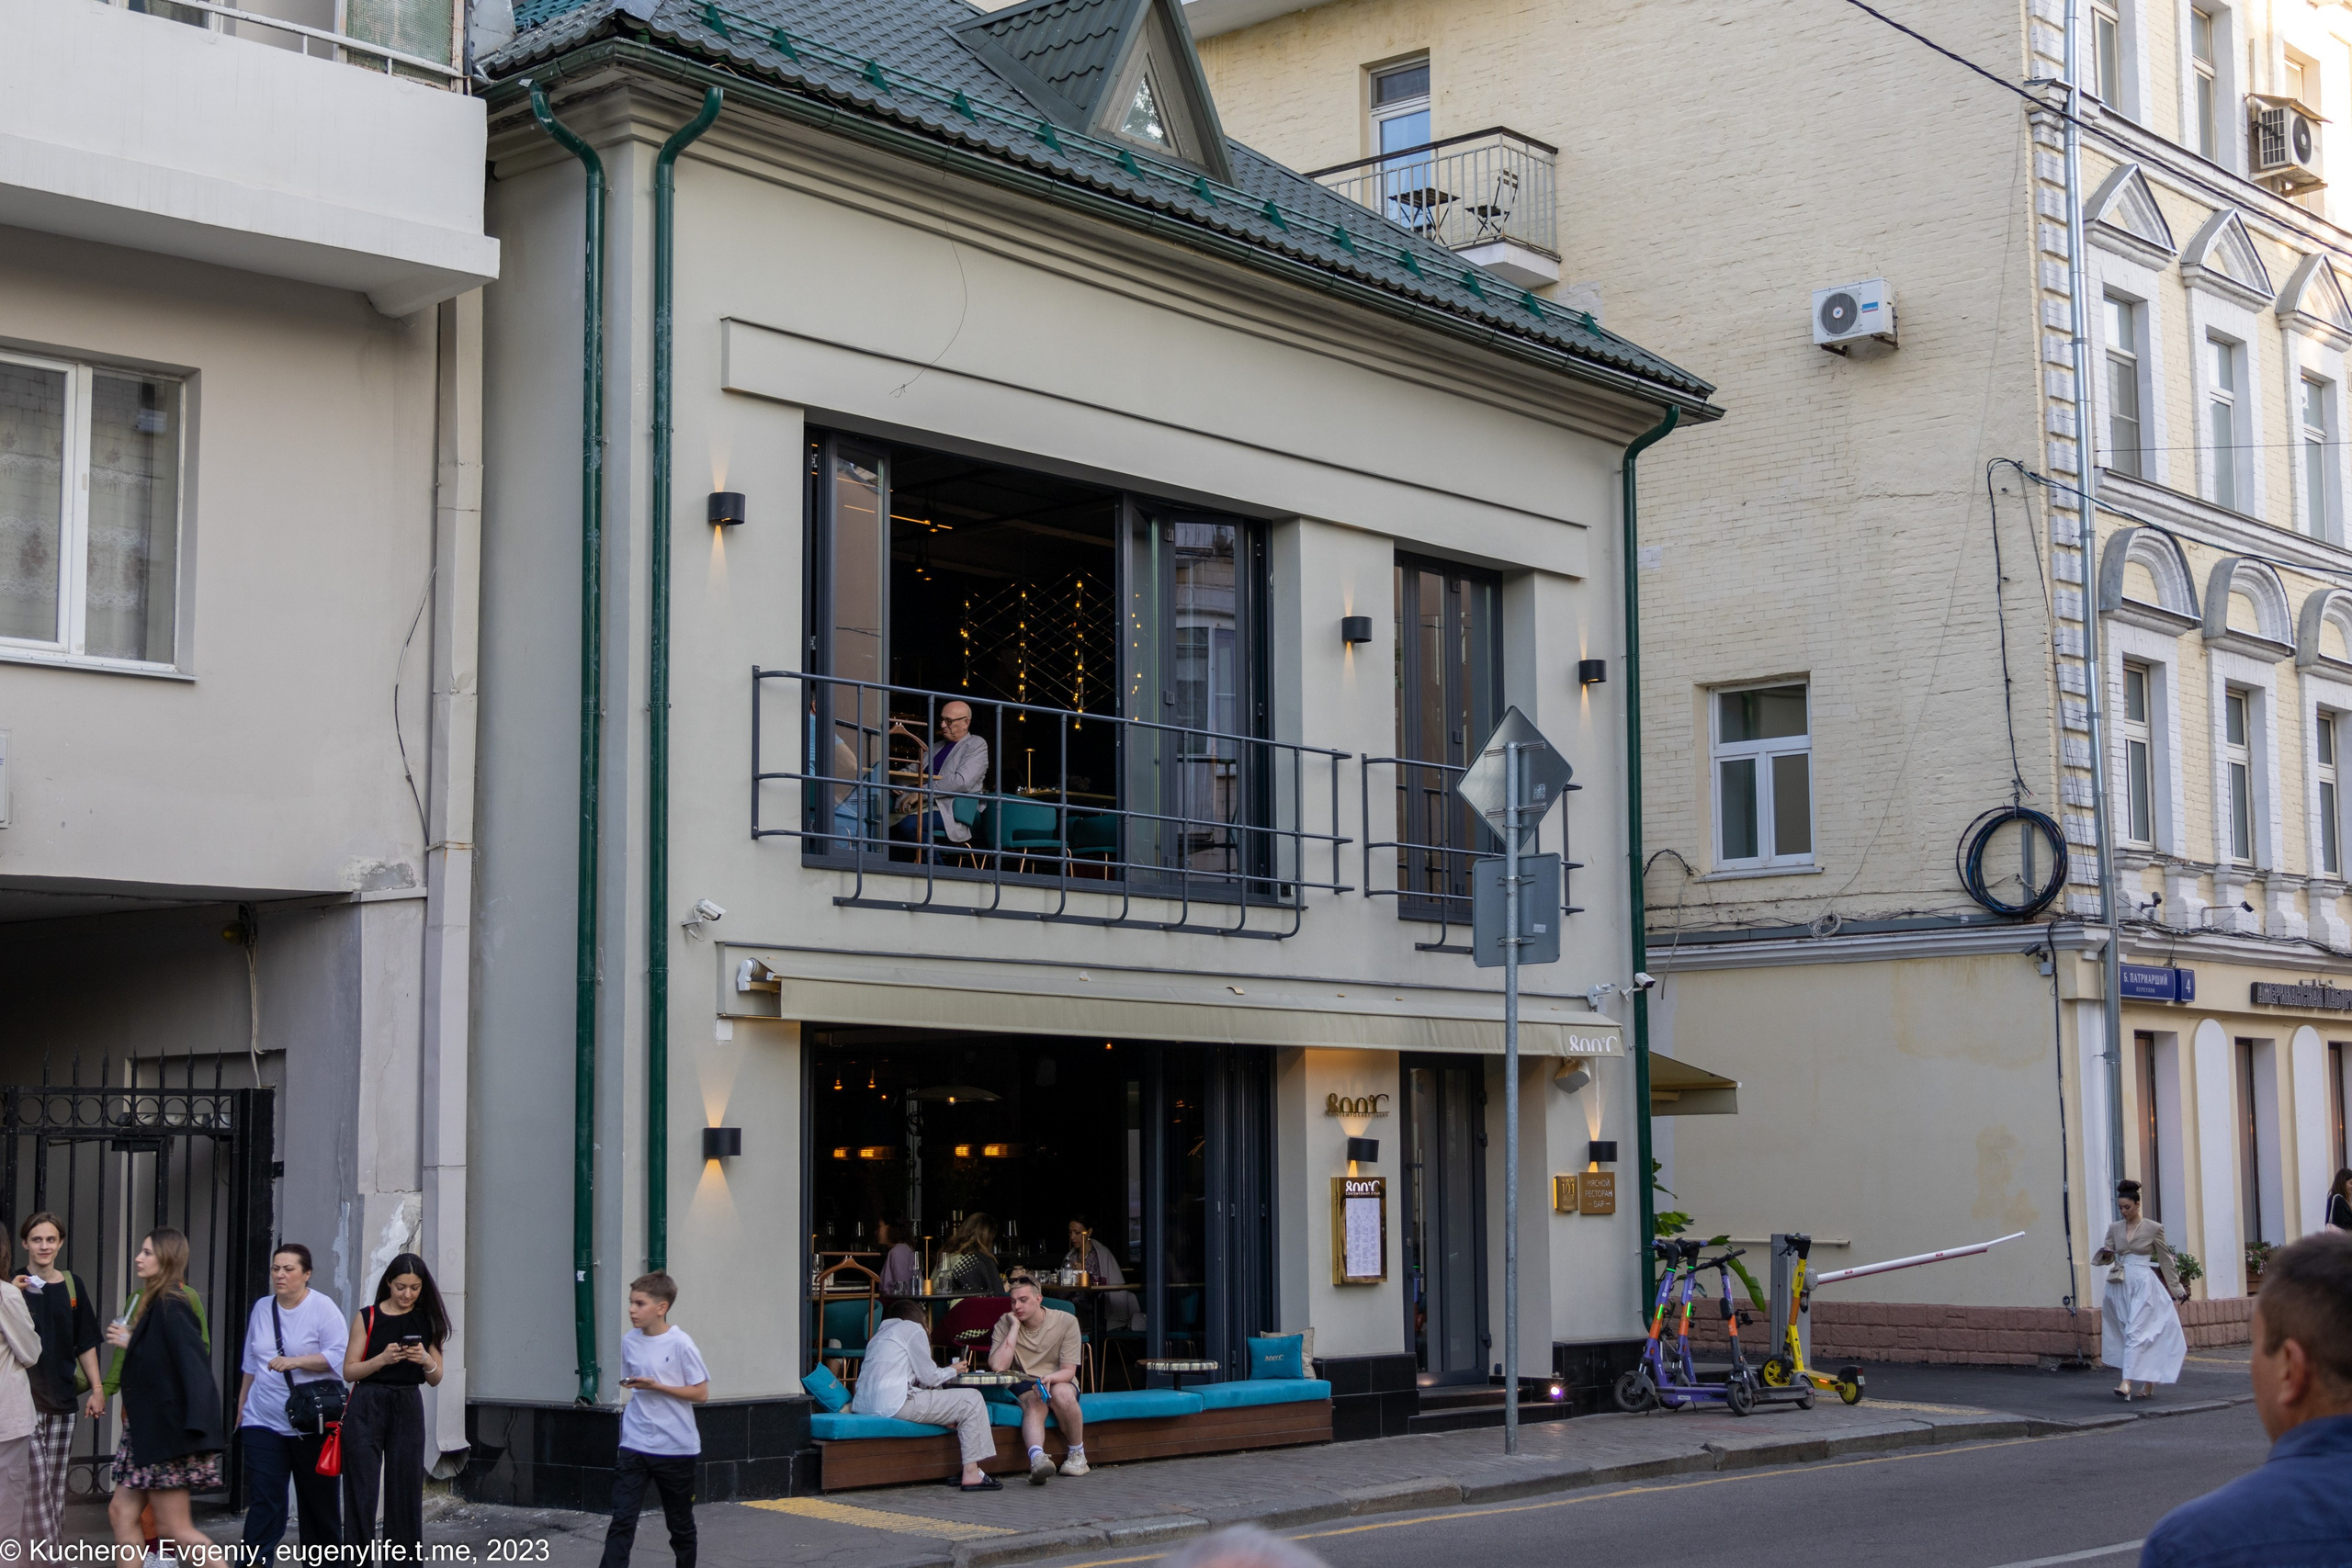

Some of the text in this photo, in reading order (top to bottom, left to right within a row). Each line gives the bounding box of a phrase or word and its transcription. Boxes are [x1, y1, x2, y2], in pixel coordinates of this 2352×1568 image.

[2123, 972, 2168, 986] Б. ПАТРИАРШИЙ
[2185, 978, 2191, 994] 4
[2256, 982, 2352, 1010] АМЕРИКАНСКАЯ ЛАБОР
[1562, 1182, 1575, 1194] 101
[1587, 1178, 1611, 1188] МЯСНОЙ
[1585, 1190, 1613, 1198] РЕСТОРАН
[1593, 1200, 1605, 1208] БАР
